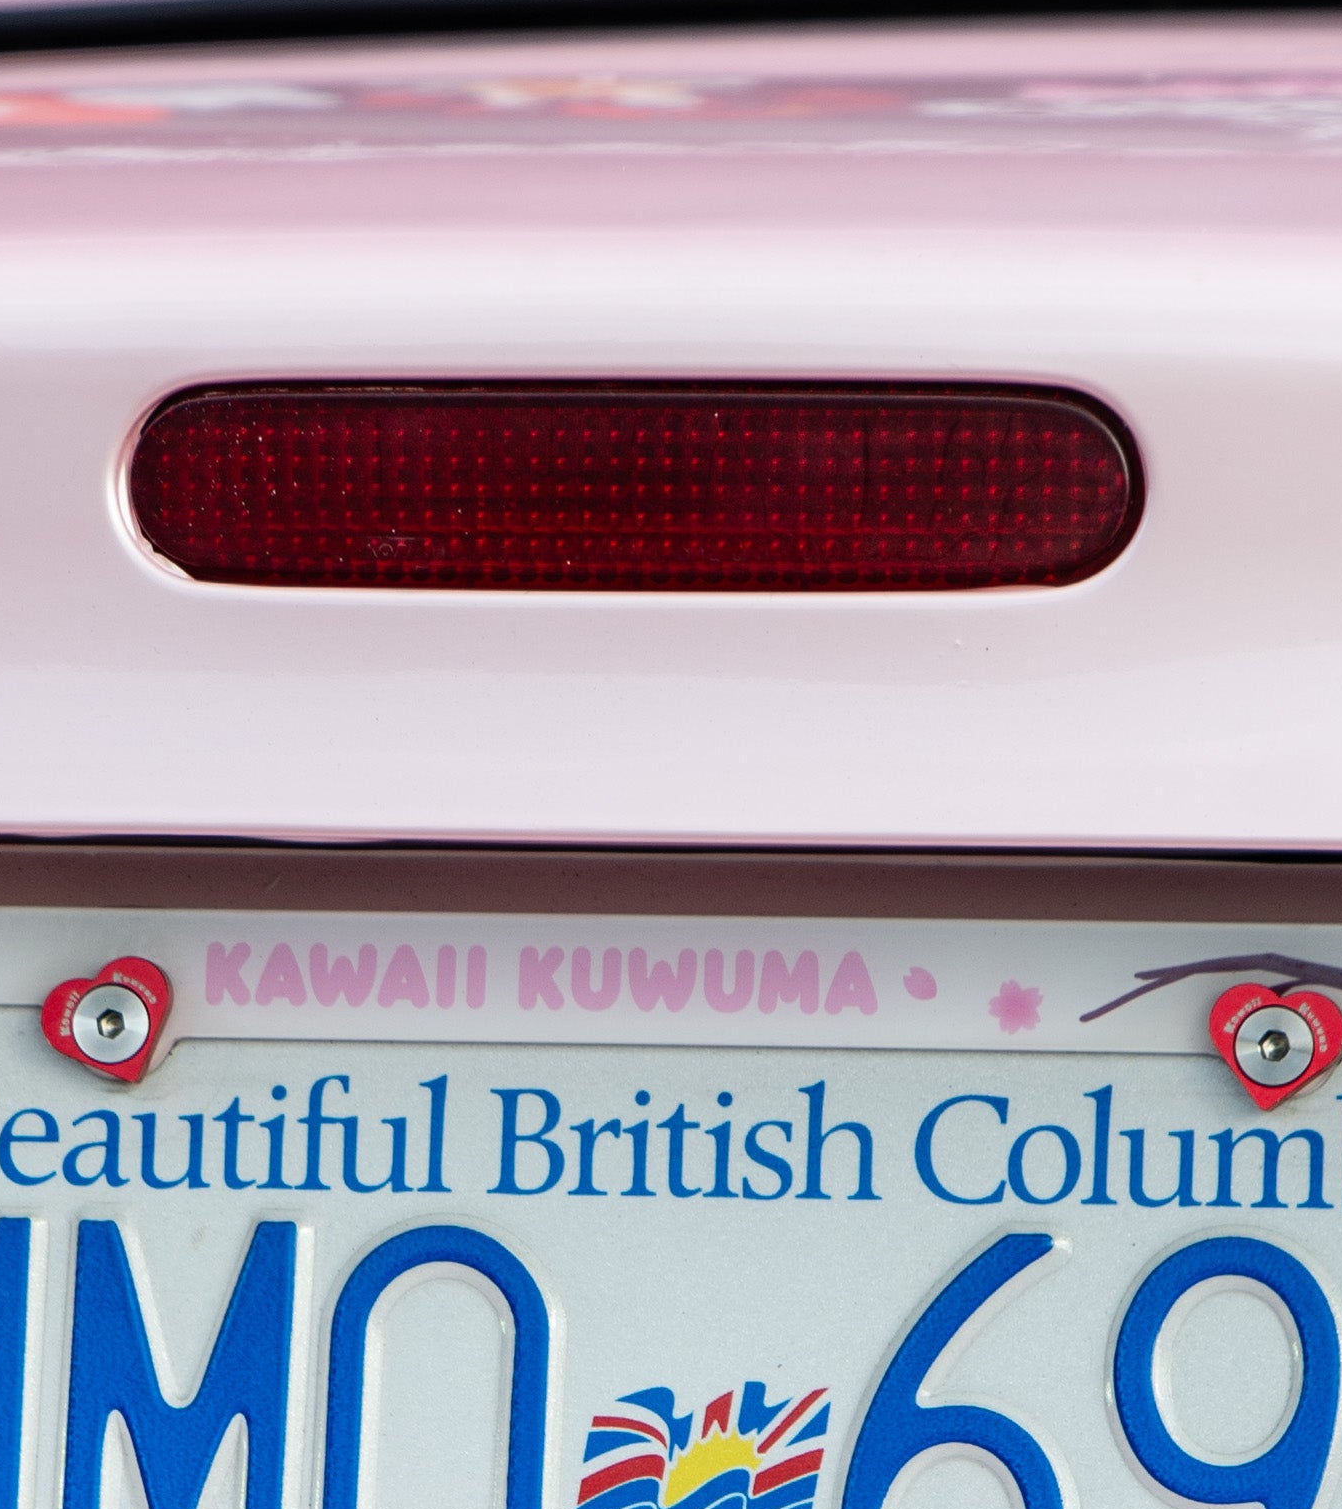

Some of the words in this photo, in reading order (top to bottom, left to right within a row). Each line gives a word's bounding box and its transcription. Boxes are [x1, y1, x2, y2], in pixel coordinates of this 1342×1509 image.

[205, 941, 487, 1010] KAWAII
[518, 946, 879, 1015] KUWUMA
[486, 1079, 882, 1201] British
